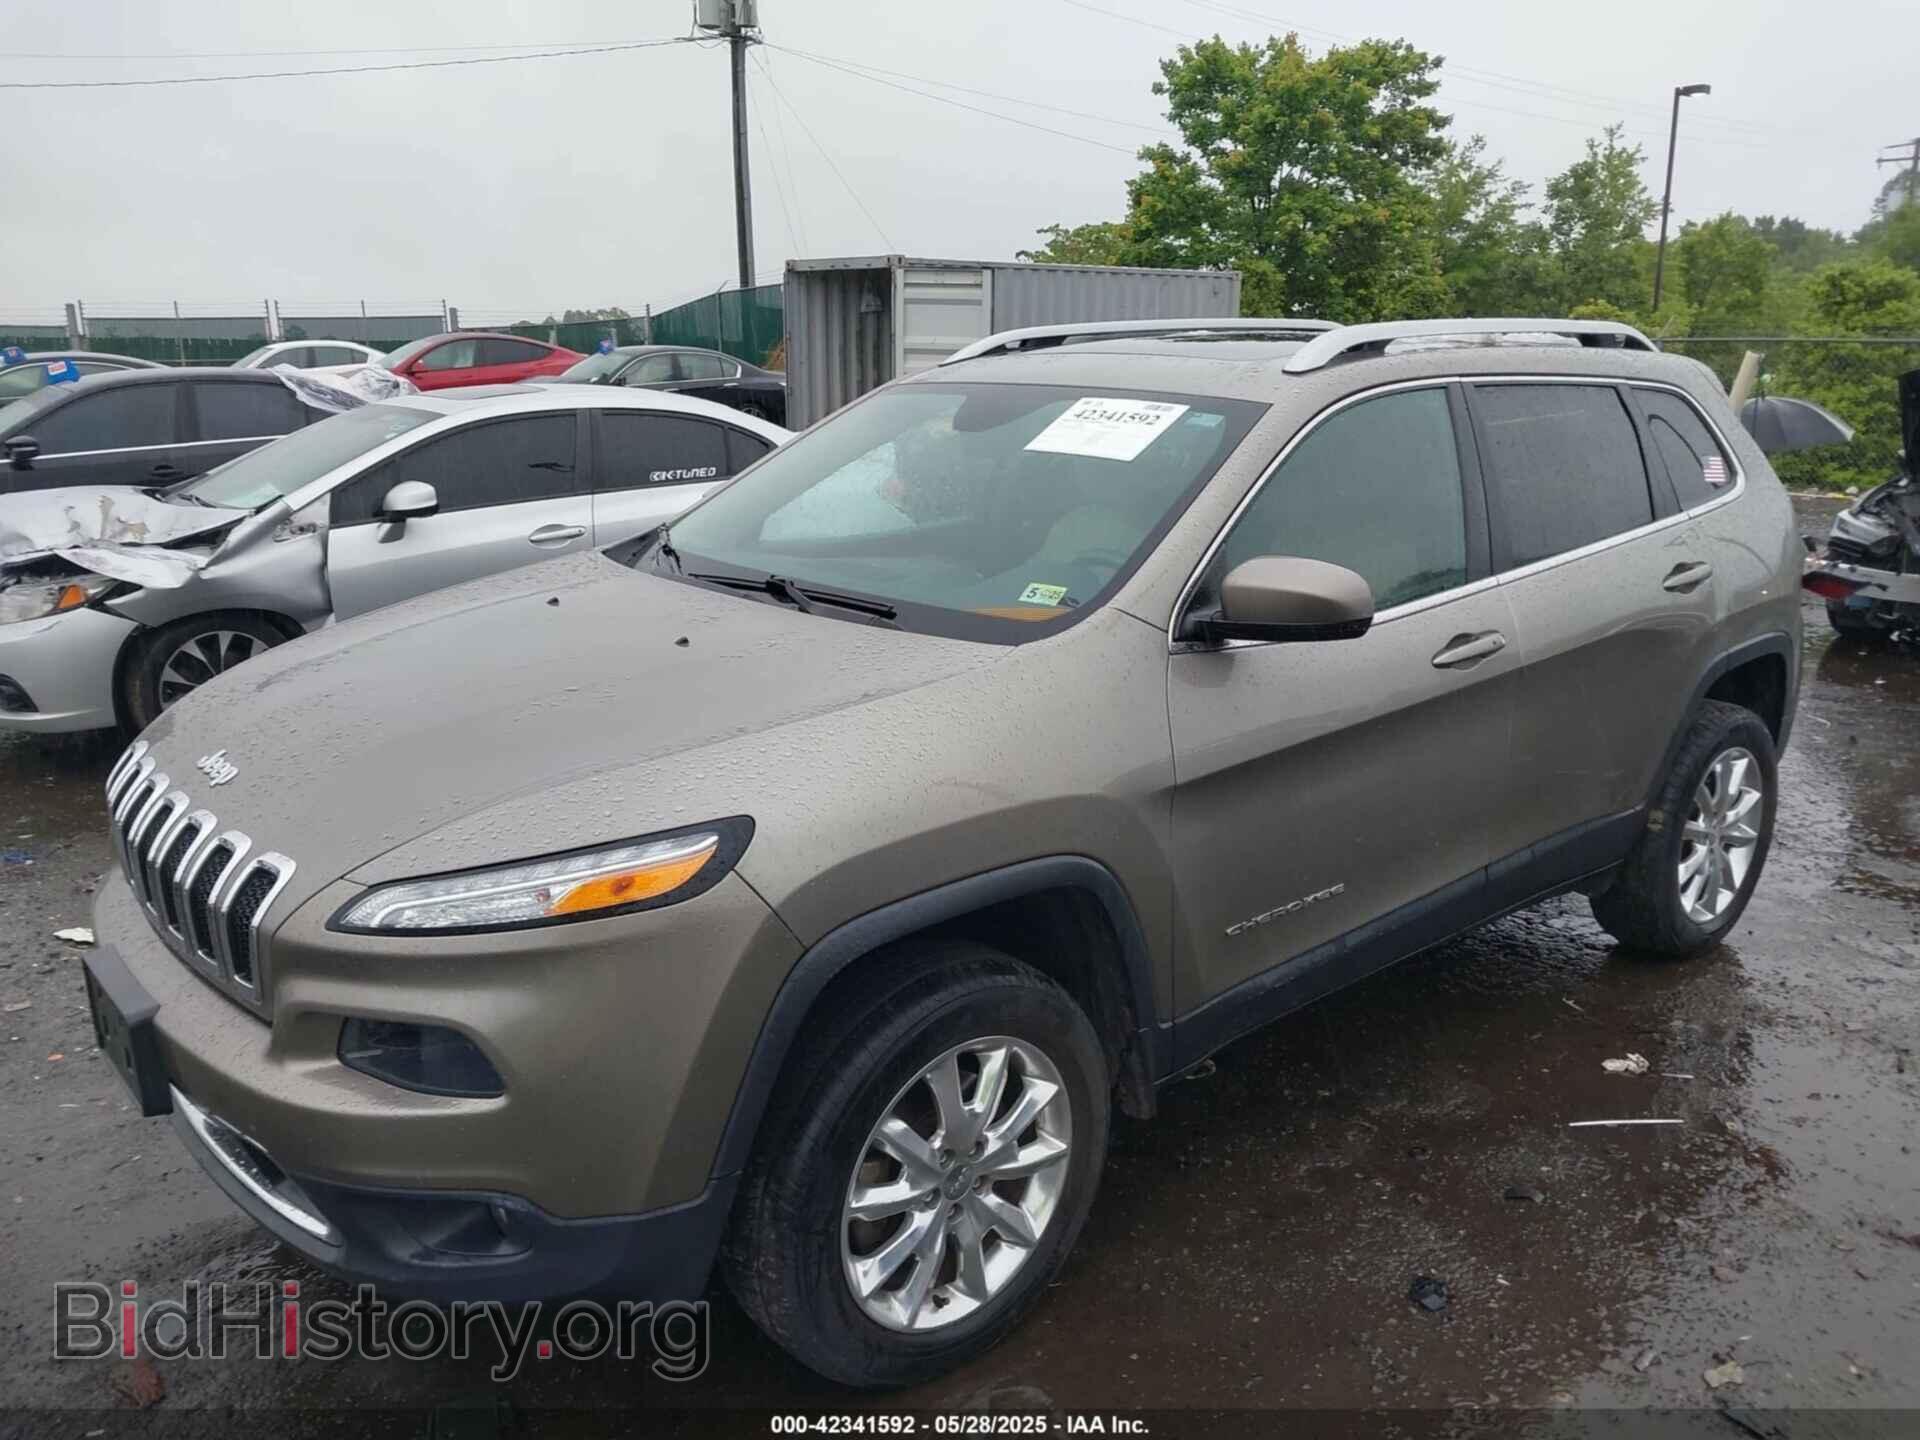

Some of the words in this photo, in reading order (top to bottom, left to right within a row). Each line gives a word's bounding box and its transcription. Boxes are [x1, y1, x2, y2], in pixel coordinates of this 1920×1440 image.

[1074, 408, 1161, 425] 42341592
[1026, 587, 1040, 599] 5
[196, 749, 239, 786] Jeep
[1225, 883, 1345, 936] CHEROKEE
